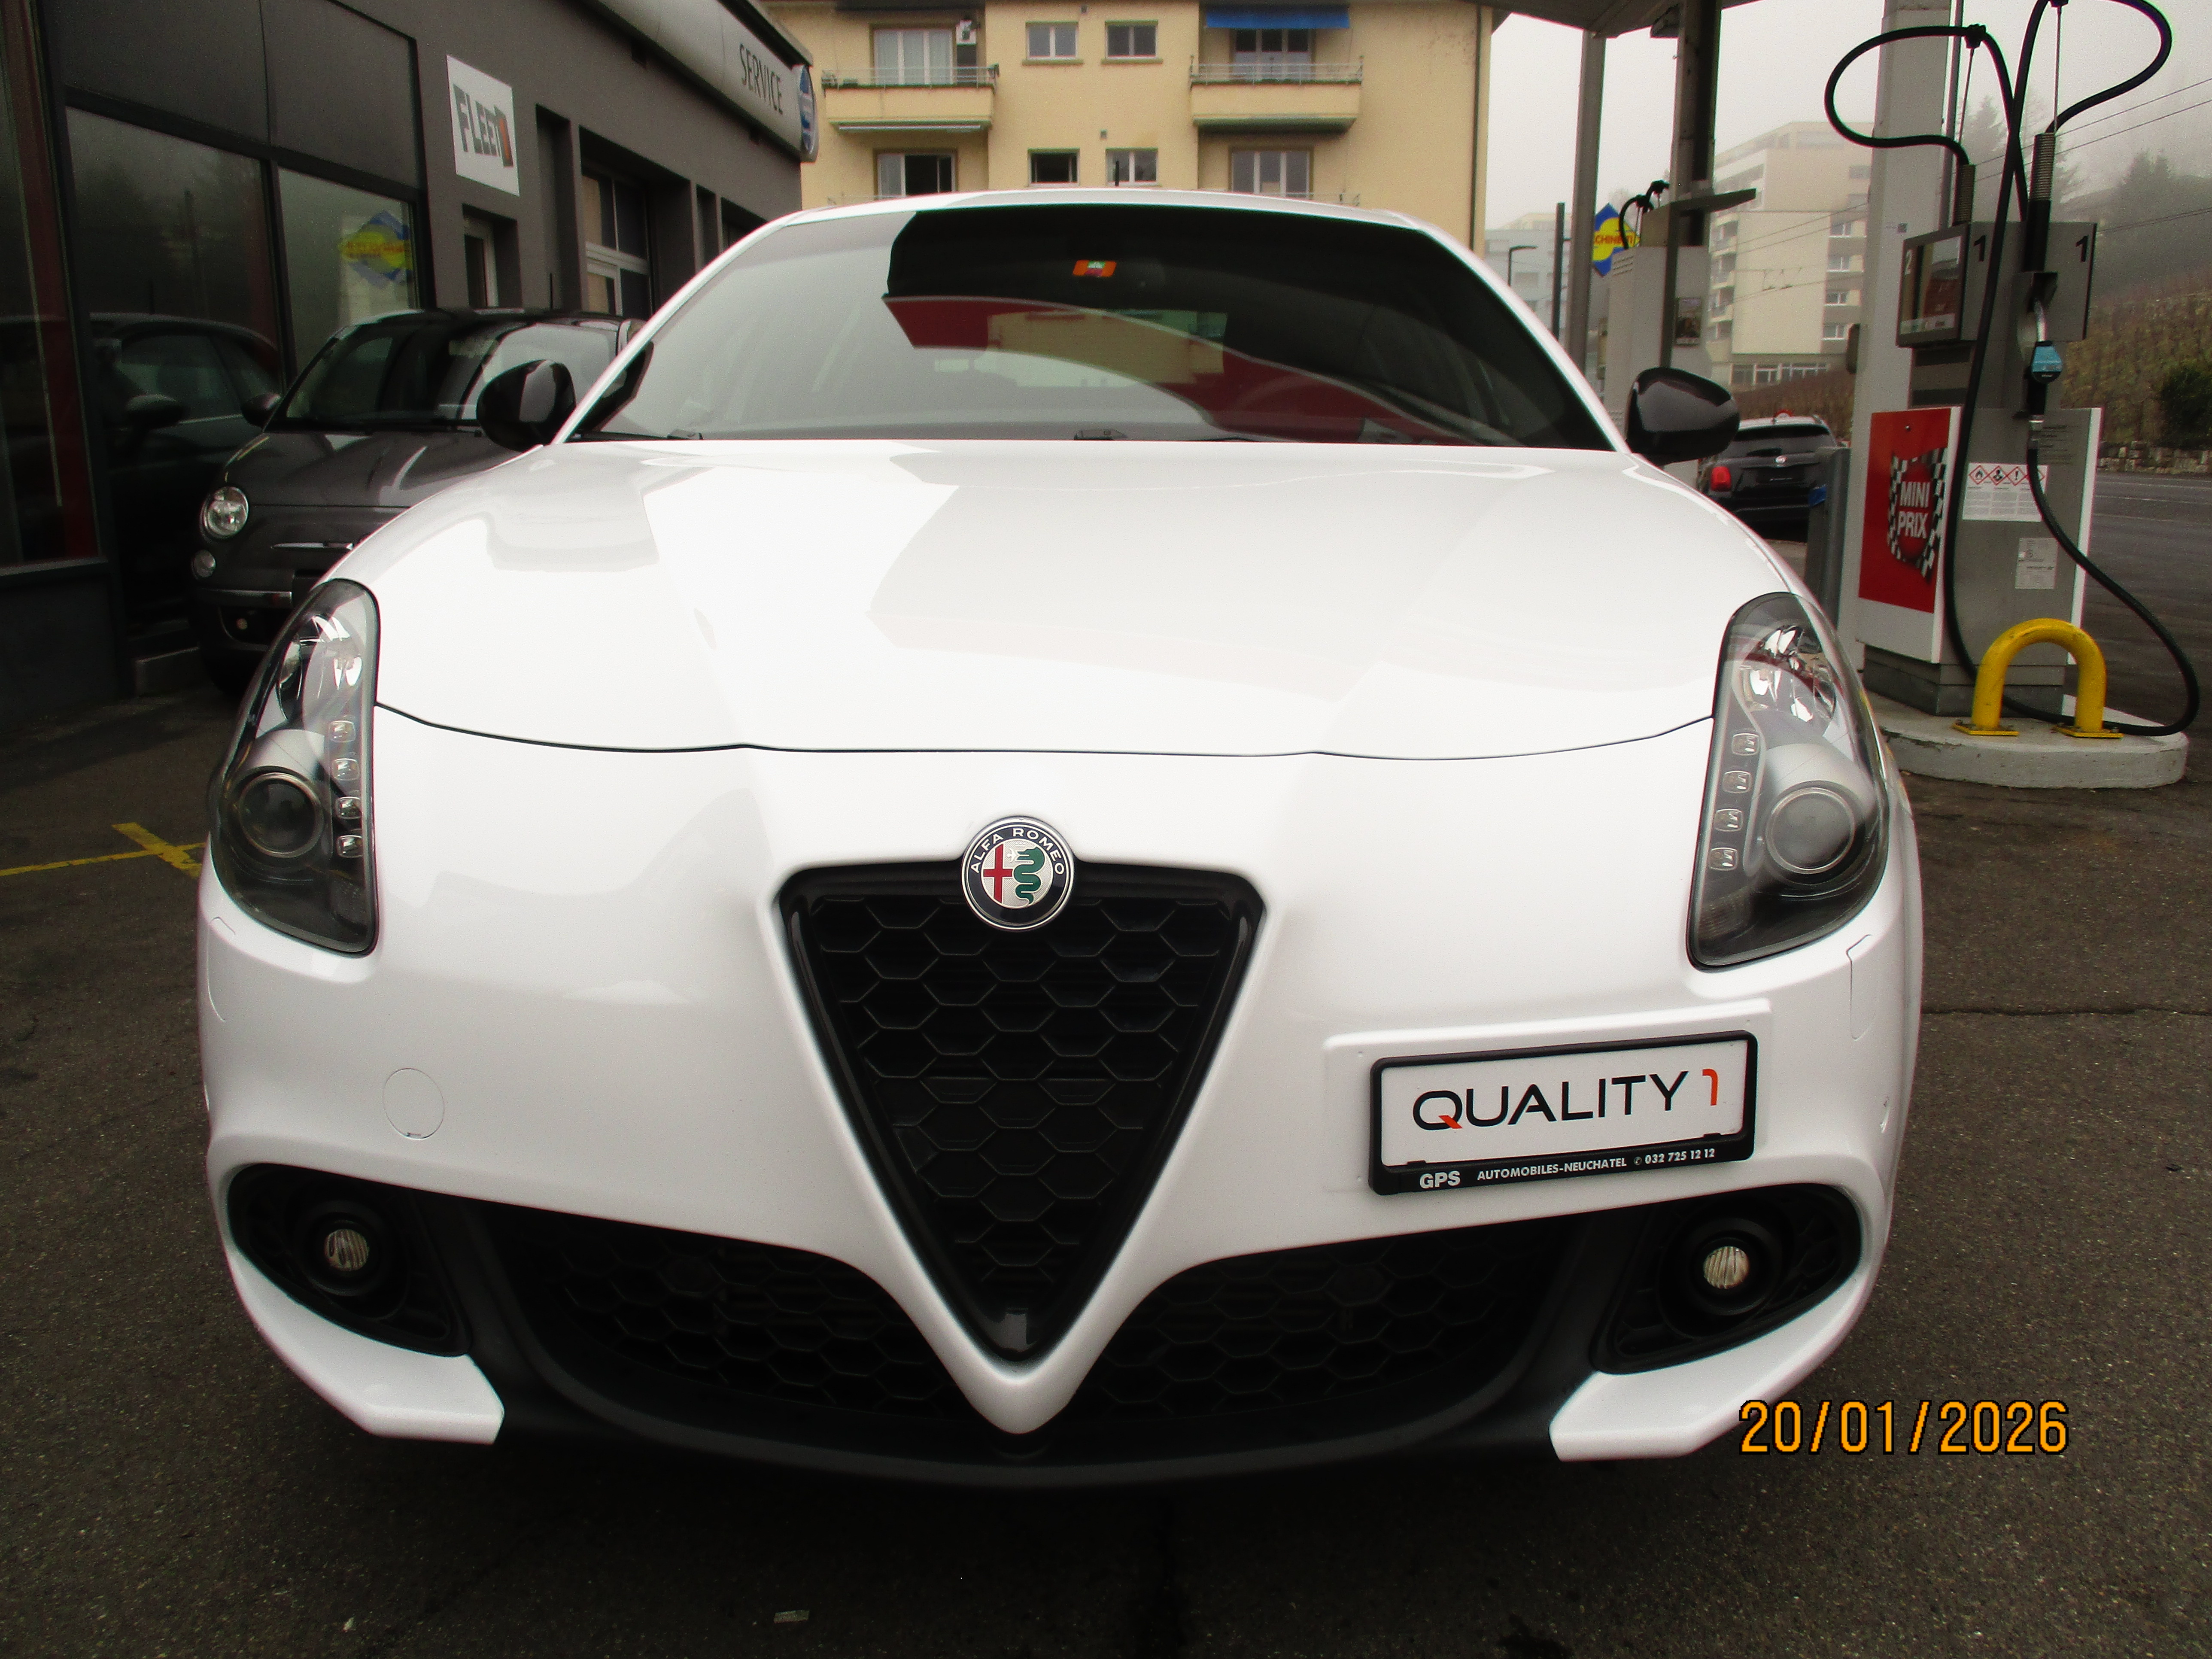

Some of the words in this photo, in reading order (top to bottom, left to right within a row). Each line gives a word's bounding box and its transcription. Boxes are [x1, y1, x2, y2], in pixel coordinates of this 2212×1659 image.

[740, 43, 783, 115] SERVICE
[1974, 235, 1987, 262] 1
[2075, 235, 2089, 262] 1
[1899, 481, 1930, 508] MINI
[1897, 510, 1928, 538] PRIX
[971, 833, 1004, 873] ALFA
[1012, 828, 1064, 875] ROMEO
[1413, 1071, 1688, 1130] QUALITY
[1702, 1069, 1718, 1106] 1
[1419, 1171, 1461, 1189] GPS
[1477, 1158, 1627, 1181] AUTOMOBILES-NEUCHATEL
[1644, 1153, 1665, 1164] 032
[1668, 1151, 1687, 1162] 725
[1690, 1149, 1701, 1159] 12
[1704, 1148, 1715, 1158] 12
